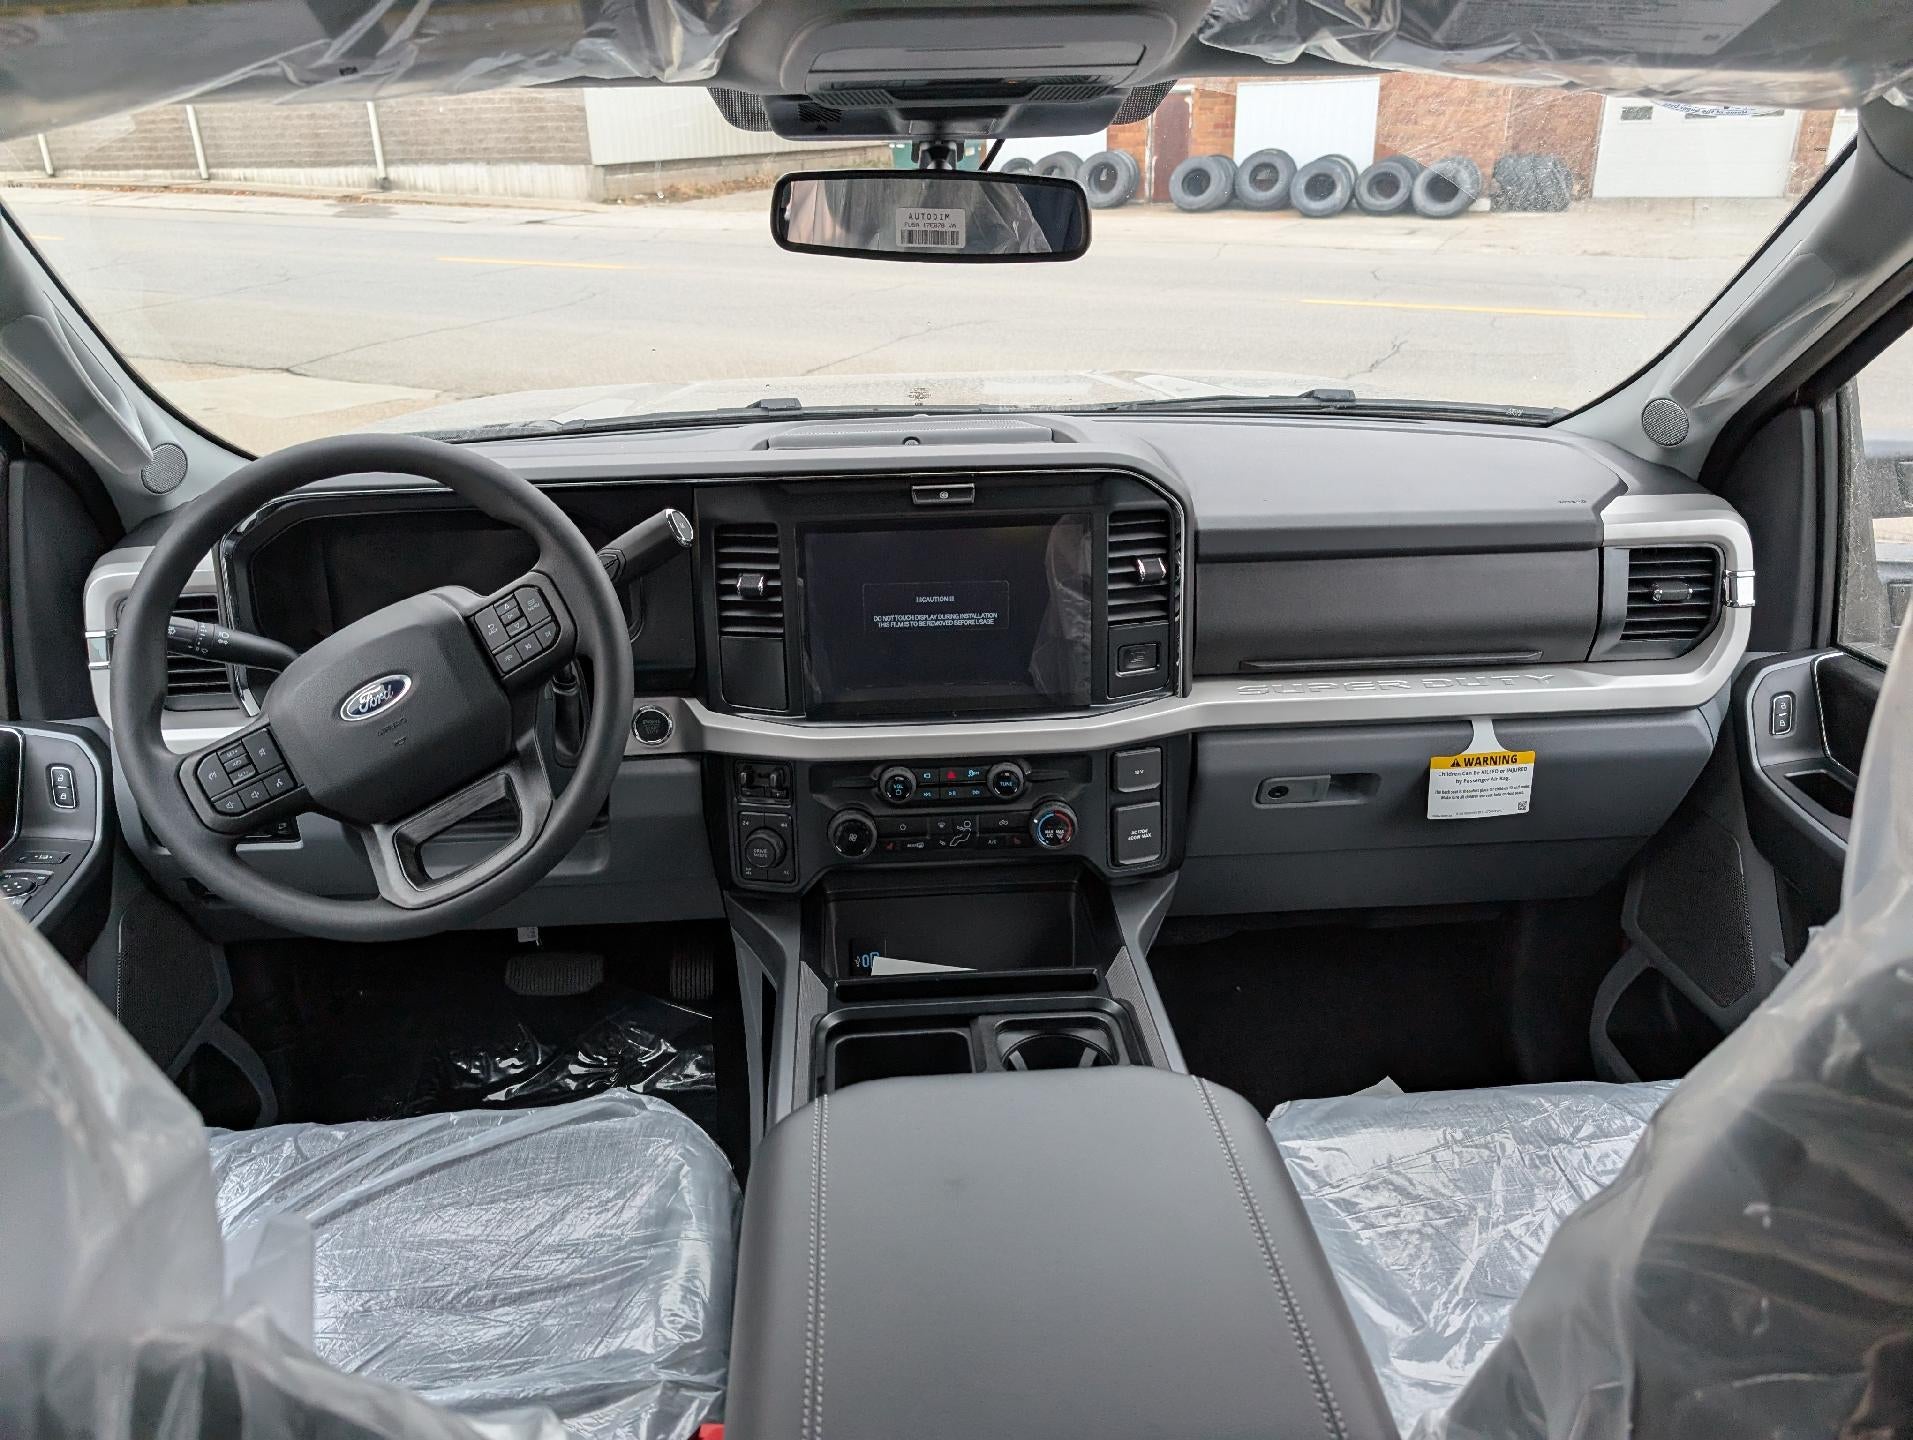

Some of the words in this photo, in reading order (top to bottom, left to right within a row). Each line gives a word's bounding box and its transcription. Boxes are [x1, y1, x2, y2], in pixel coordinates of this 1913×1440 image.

[908, 212, 950, 221] AUTODIM
[1236, 679, 1412, 695] SUPER
[1421, 674, 1556, 689] DUTY
[359, 684, 394, 712] Ford
[1464, 754, 1518, 767] WARNING
